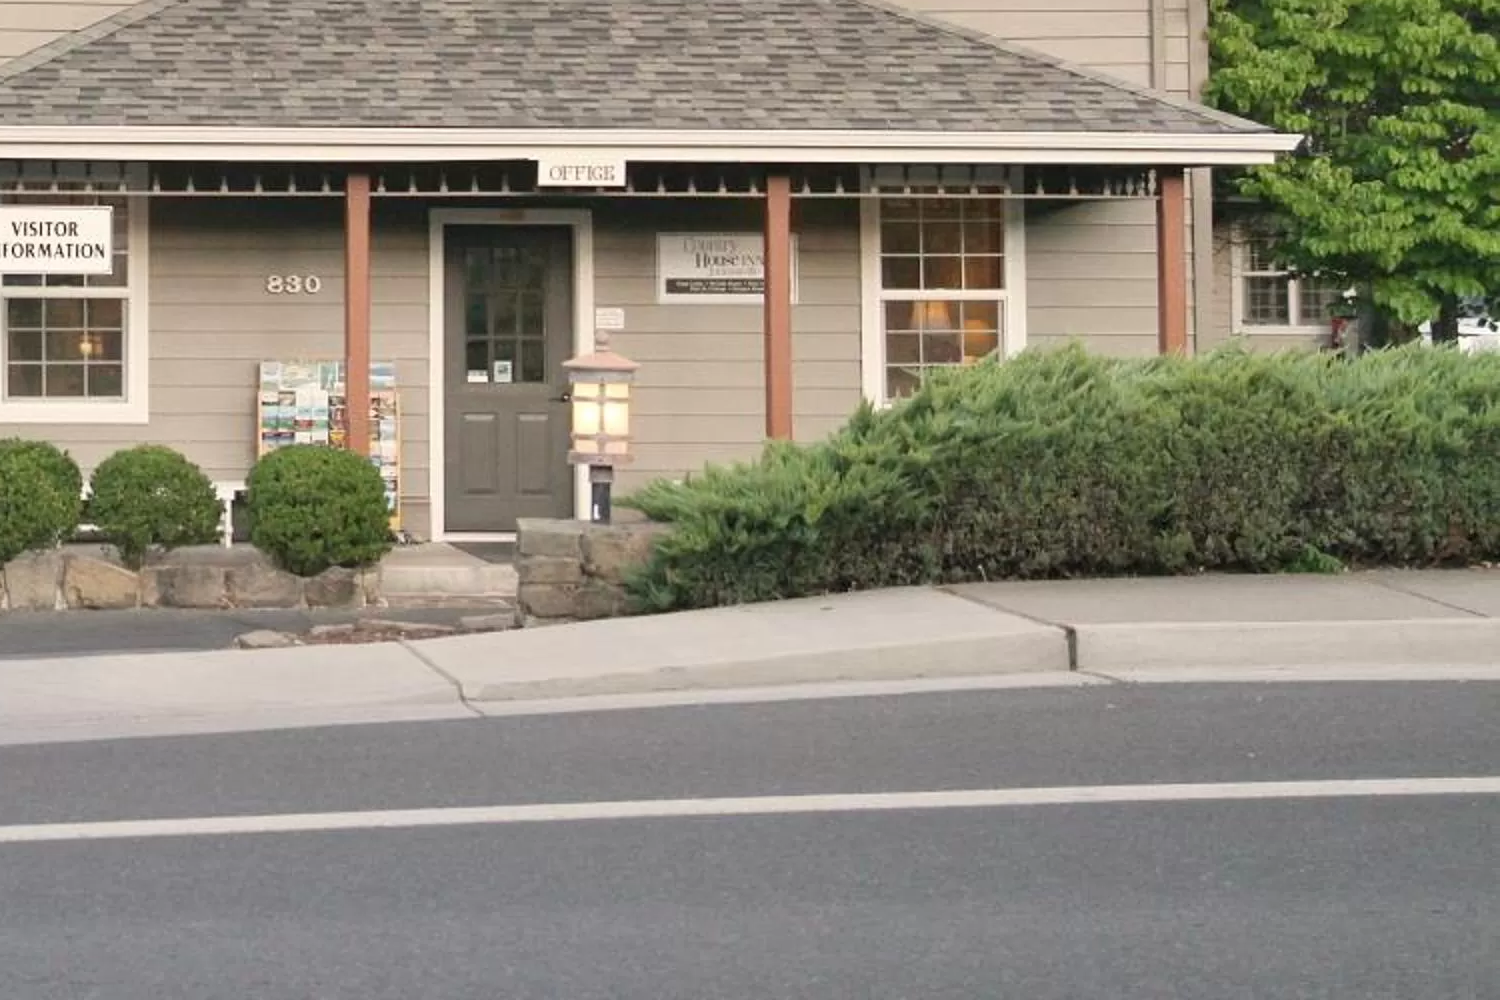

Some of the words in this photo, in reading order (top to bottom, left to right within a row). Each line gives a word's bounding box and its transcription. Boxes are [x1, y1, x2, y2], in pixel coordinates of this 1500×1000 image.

[550, 165, 615, 181] OFFICE
[11, 221, 79, 237] VISITOR
[266, 275, 321, 293] 830
